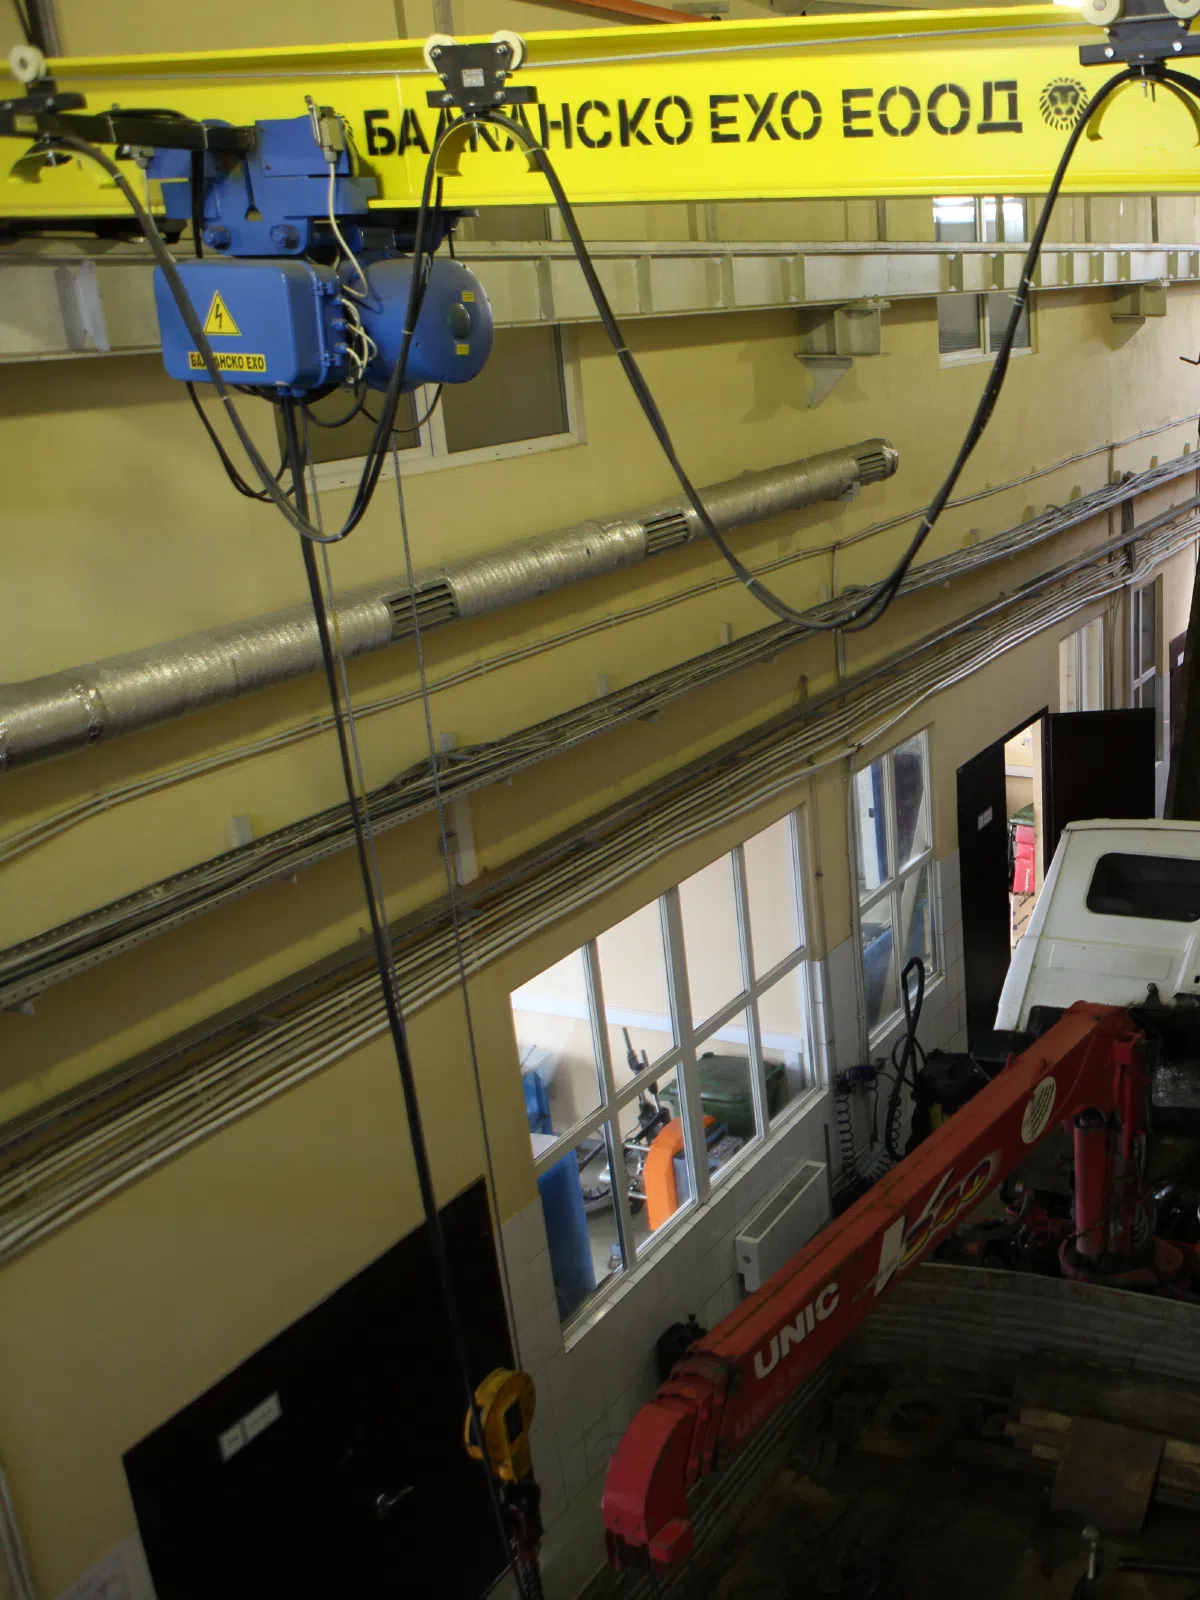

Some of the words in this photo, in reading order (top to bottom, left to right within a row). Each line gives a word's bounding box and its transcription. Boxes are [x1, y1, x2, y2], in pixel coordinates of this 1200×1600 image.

[709, 90, 822, 143] ЕХО
[842, 80, 1023, 138] ЕООД
[190, 354, 244, 369] БААНСКО
[246, 356, 264, 370] ЕХО
[753, 1282, 841, 1379] UNIC
